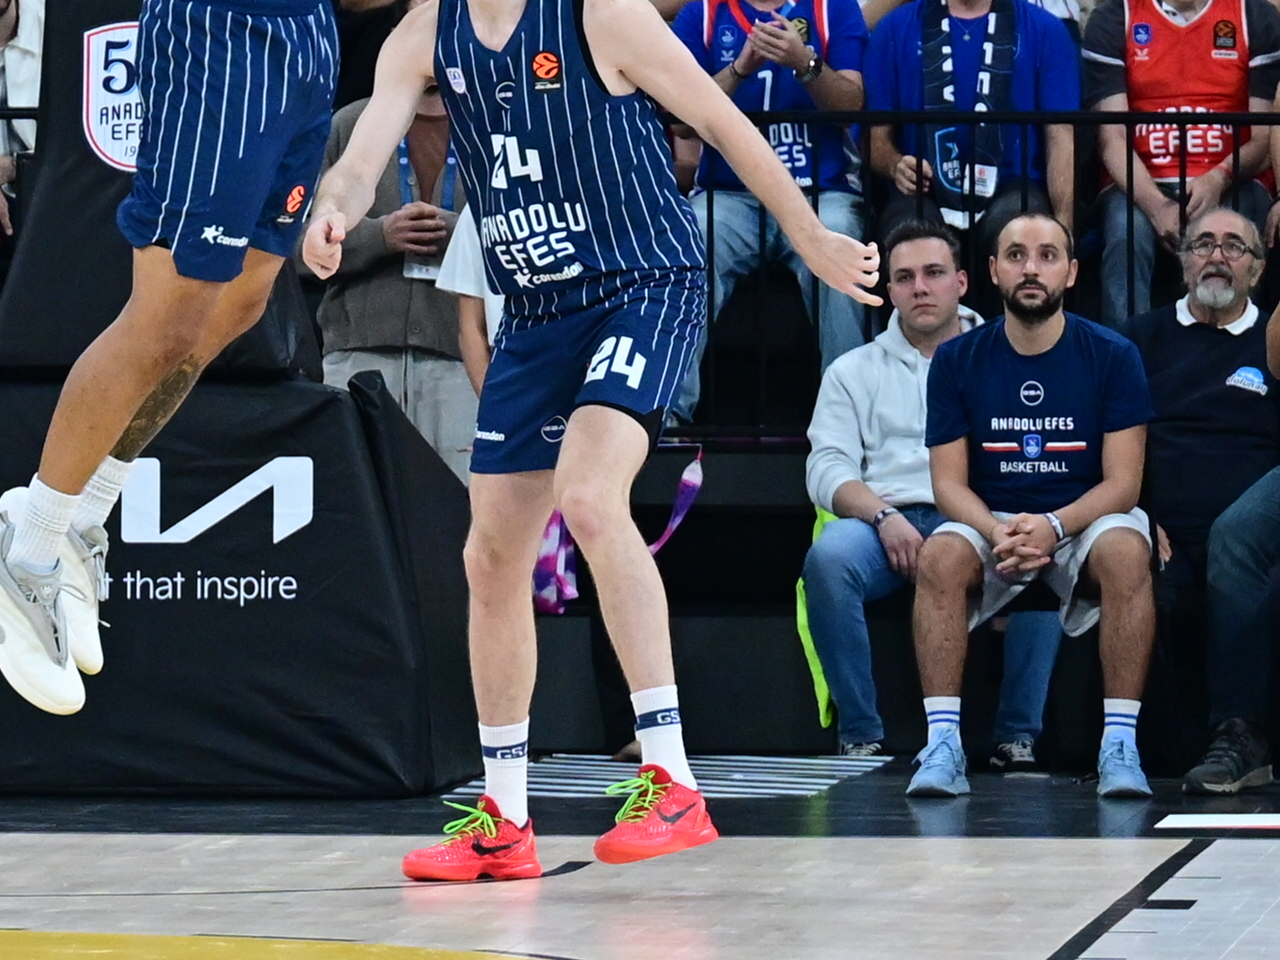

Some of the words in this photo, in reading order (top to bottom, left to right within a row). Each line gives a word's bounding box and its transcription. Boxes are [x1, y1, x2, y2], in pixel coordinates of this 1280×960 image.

[101, 39, 137, 95] 5
[757, 70, 774, 112] 7
[1148, 129, 1224, 154] EFES
[490, 133, 545, 190] 24
[481, 201, 587, 249] ANADOLU
[494, 230, 576, 269] EFES
[531, 260, 585, 286] corendon
[582, 335, 648, 390] 24
[990, 416, 1043, 432] ANADOLU
[1044, 416, 1075, 431] EFES
[999, 460, 1070, 474] BASKETBALL
[122, 570, 186, 600] that
[196, 569, 298, 607] inspire
